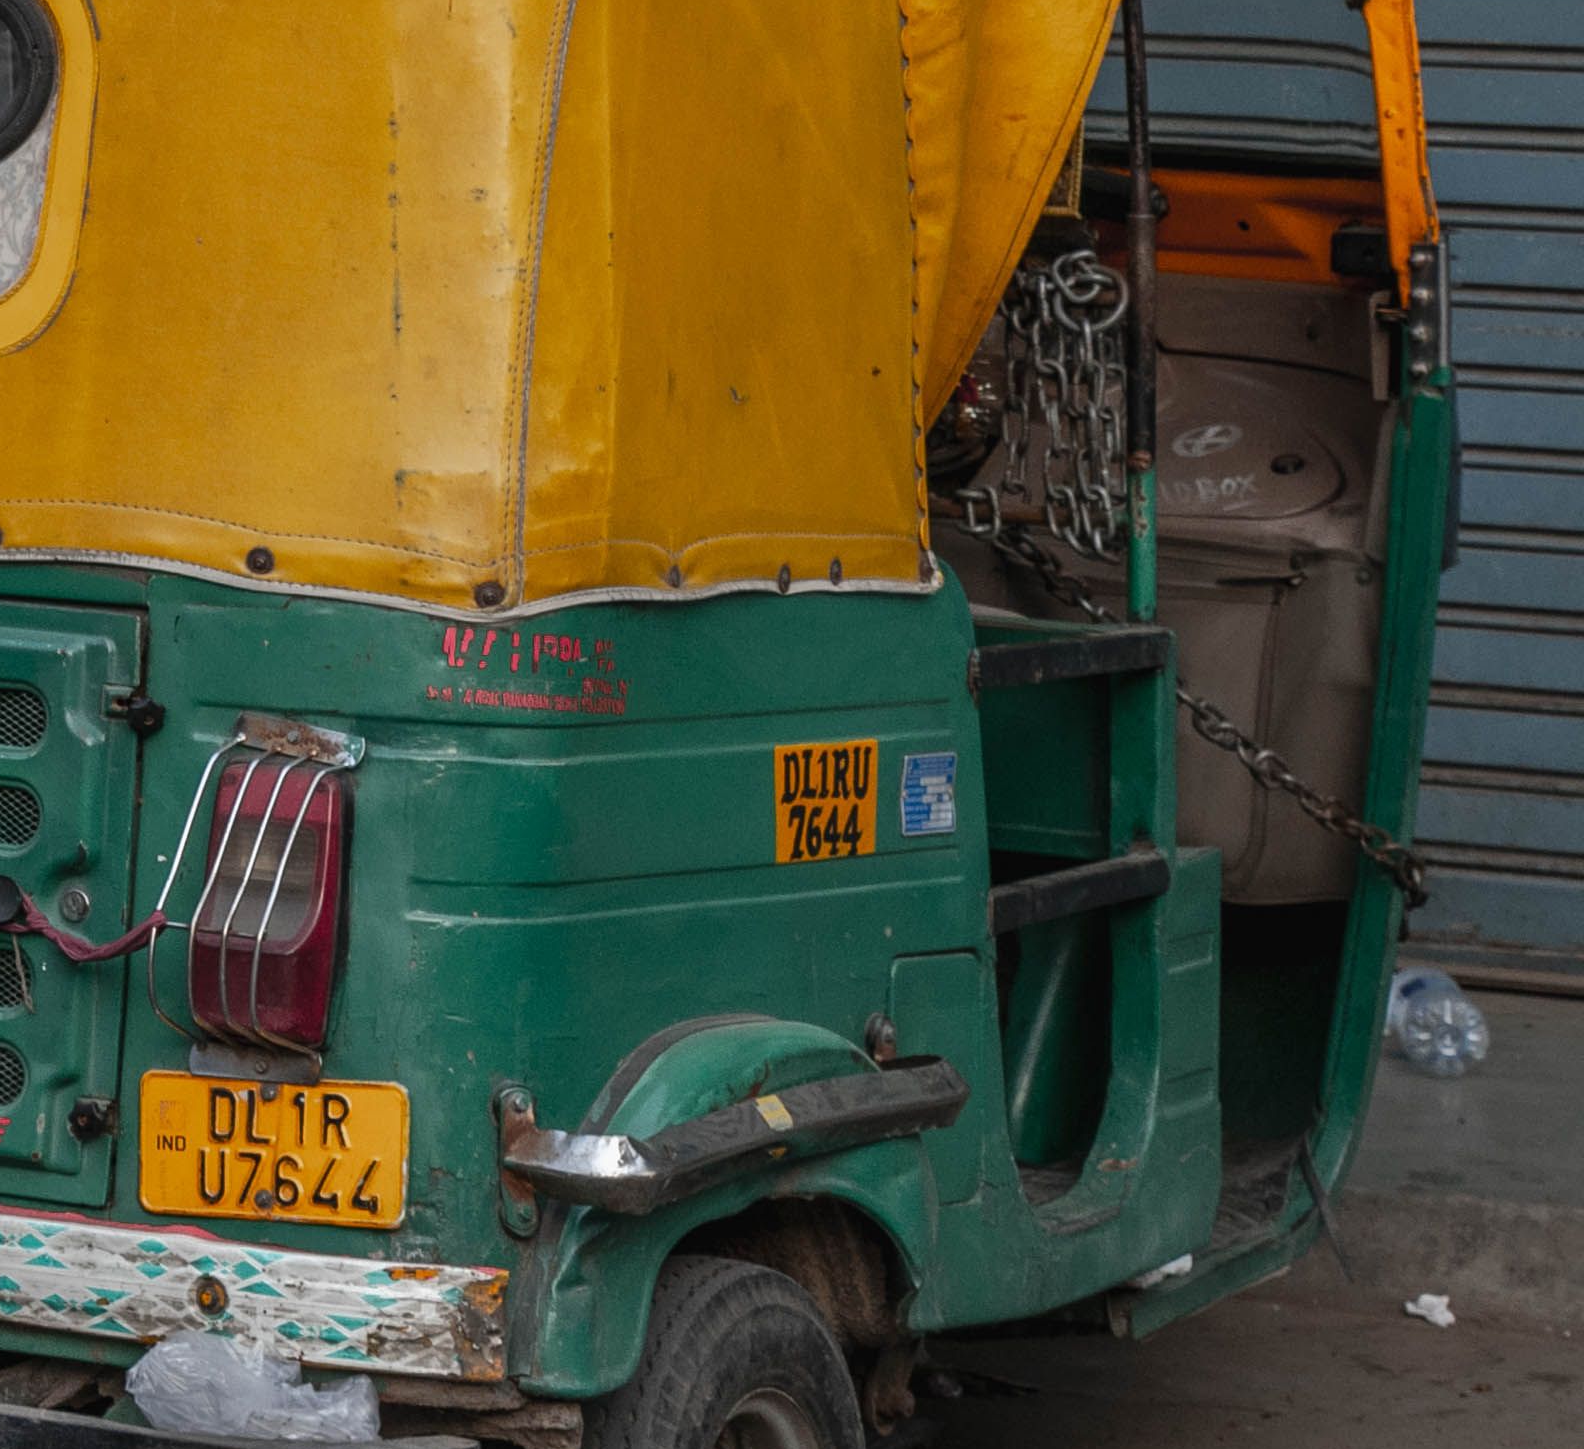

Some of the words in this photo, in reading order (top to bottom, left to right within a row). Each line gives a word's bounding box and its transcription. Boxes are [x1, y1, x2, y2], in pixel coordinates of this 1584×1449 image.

[780, 747, 875, 806] DL1RU
[788, 802, 864, 861] 7644
[155, 1133, 188, 1152] IND
[208, 1087, 354, 1150] DL1R
[198, 1147, 382, 1216] U7644
